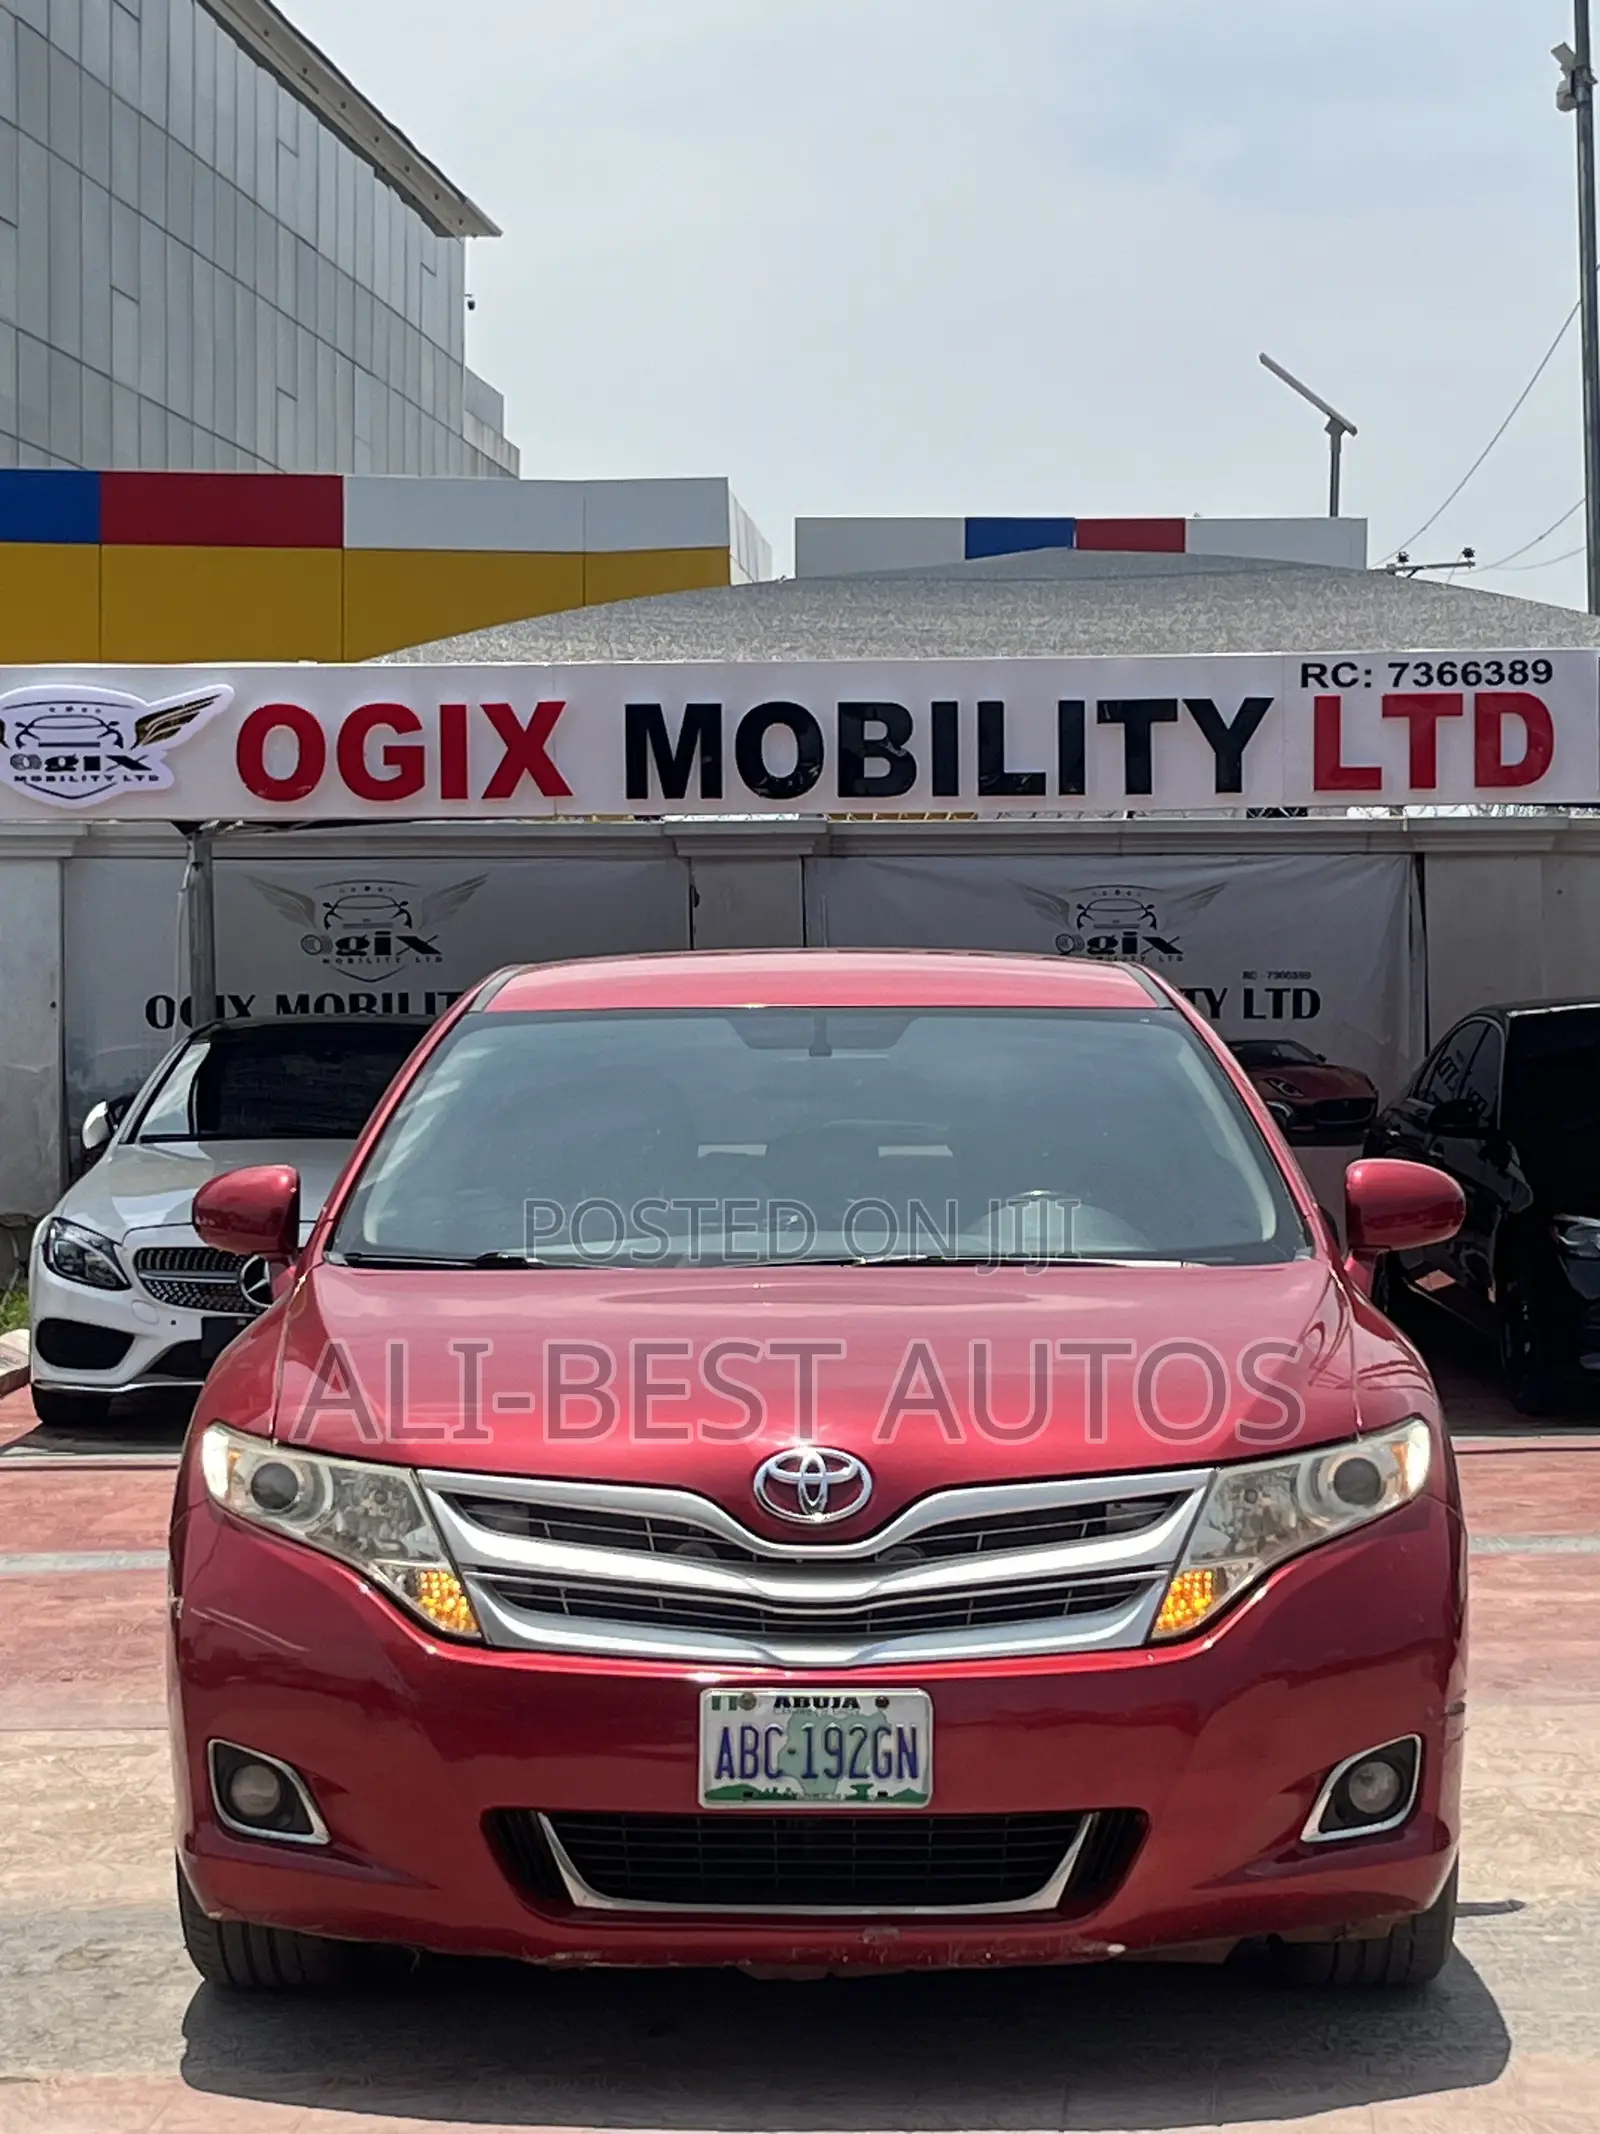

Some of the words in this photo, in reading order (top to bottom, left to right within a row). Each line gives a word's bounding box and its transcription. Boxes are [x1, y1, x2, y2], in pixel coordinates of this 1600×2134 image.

[1300, 662, 1373, 689] RC:
[1388, 657, 1554, 687] 7366389
[235, 701, 574, 802] OGIX
[624, 697, 1275, 801] MOBILITY
[1312, 692, 1555, 791] LTD
[13, 775, 114, 783] MOBILITY
[122, 774, 161, 783] LTD
[275, 992, 465, 1016] MOBILI
[1243, 987, 1321, 1020] LTD
[714, 1723, 919, 1780] ABC-192GN
